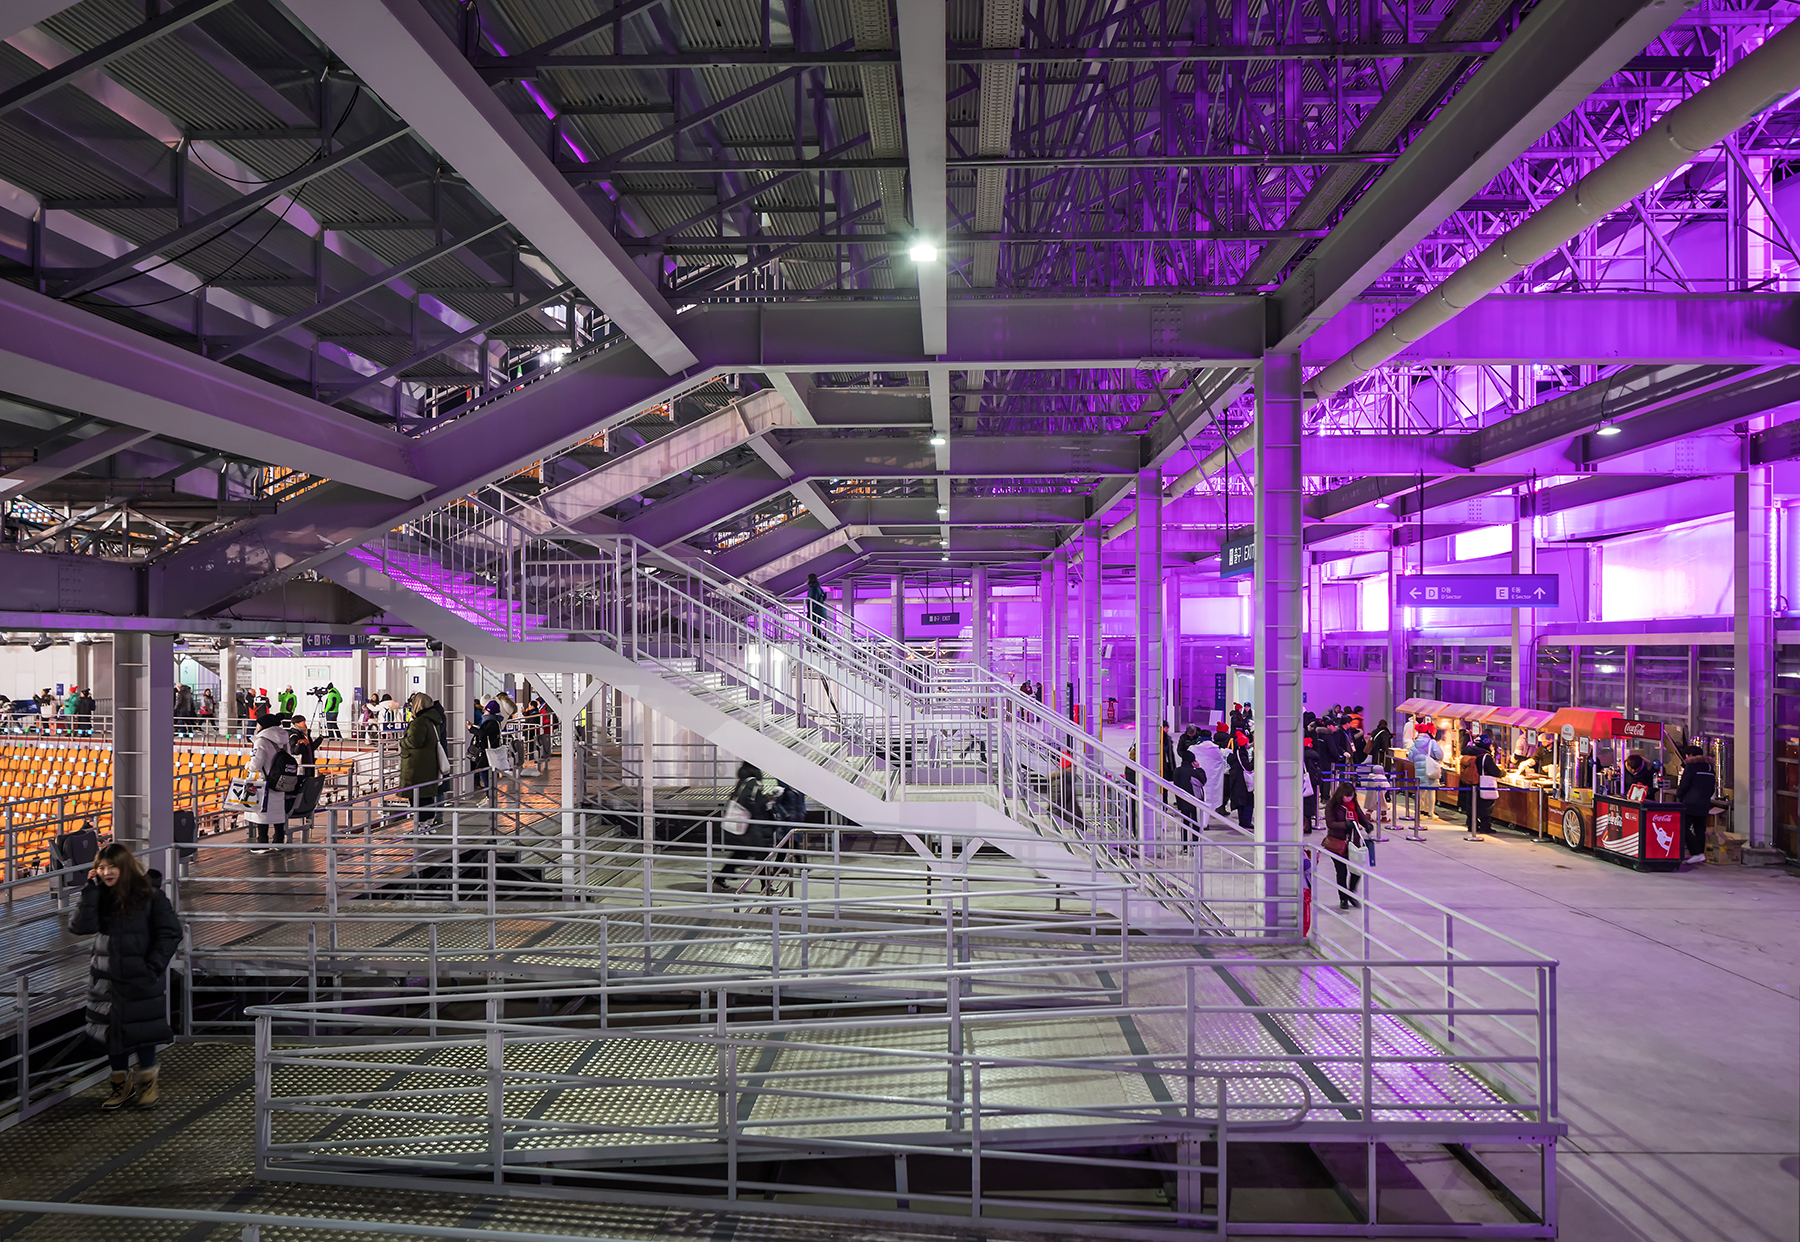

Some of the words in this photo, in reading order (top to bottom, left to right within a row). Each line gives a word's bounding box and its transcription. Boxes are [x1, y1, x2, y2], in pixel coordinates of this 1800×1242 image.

[1244, 543, 1255, 561] EXIT
[321, 635, 331, 645] 116
[357, 635, 365, 644] 117
[1623, 722, 1646, 736] Coca-Cola
[1651, 814, 1673, 822] Coca-Cola
